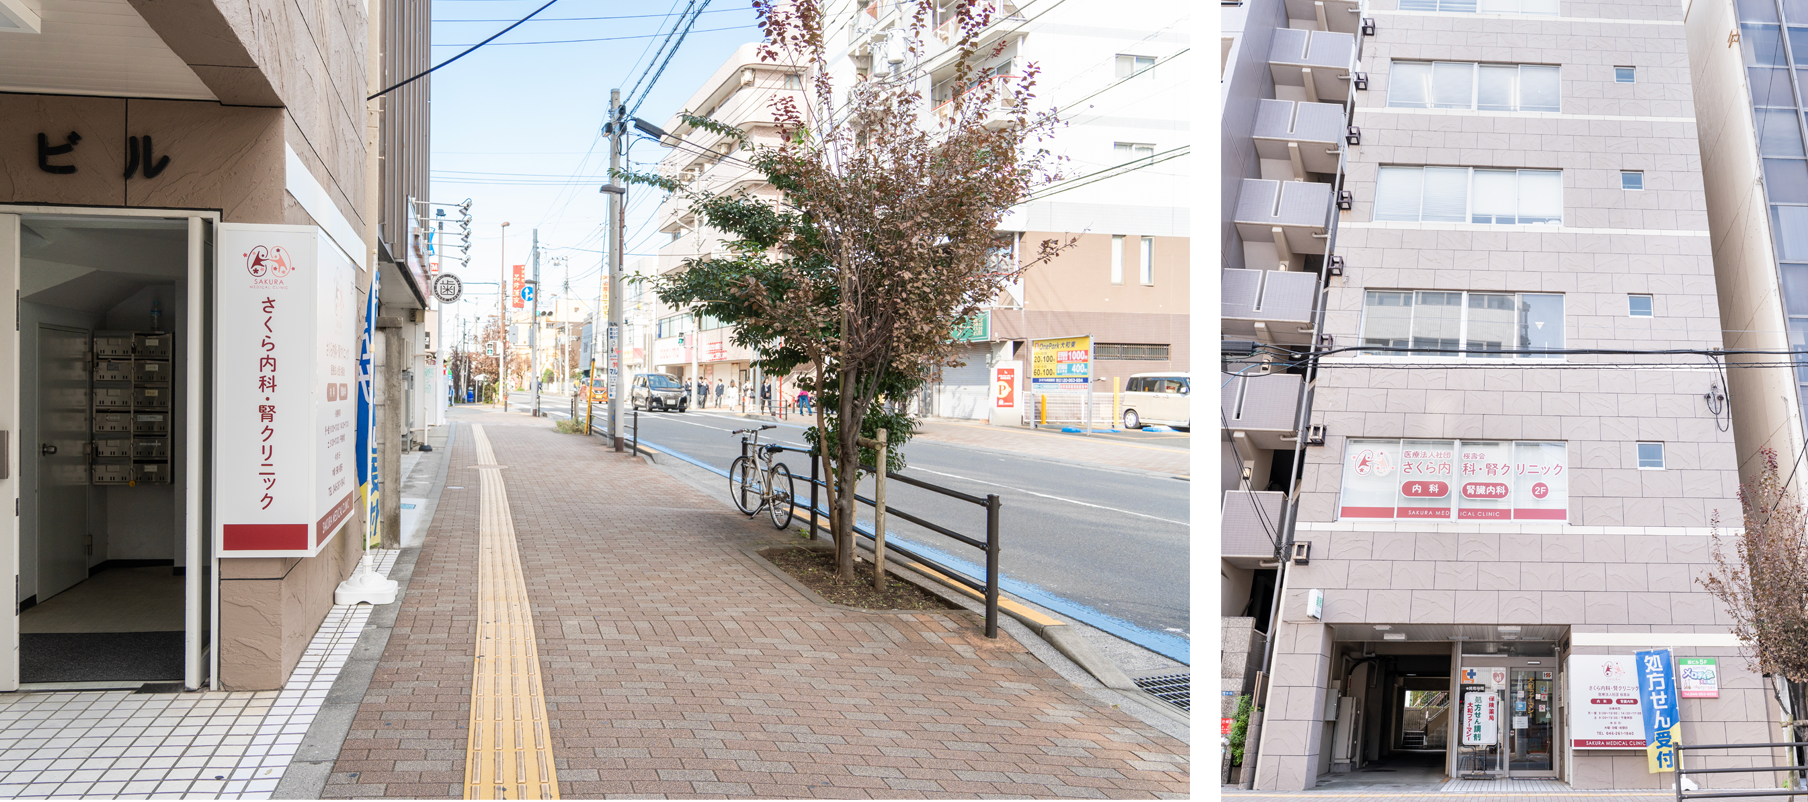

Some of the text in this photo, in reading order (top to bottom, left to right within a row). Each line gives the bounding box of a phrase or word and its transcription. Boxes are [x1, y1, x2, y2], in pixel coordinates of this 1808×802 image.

[38, 131, 171, 180] ビル
[439, 280, 456, 296] 歯
[999, 385, 1006, 395] P
[258, 296, 278, 510] さくら内科・腎クリニック
[1404, 450, 1451, 459] 医療法人社団
[1403, 461, 1563, 476] さくら内科・腎クリニック
[1412, 484, 1439, 494] 内科
[1466, 485, 1506, 495] 腎臓内科
[1534, 486, 1546, 495] 2F
[1473, 696, 1482, 741] 処方せん調剤
[1643, 655, 1674, 769] 処方せん受付
[1466, 702, 1474, 741] 大和ファーマシー
